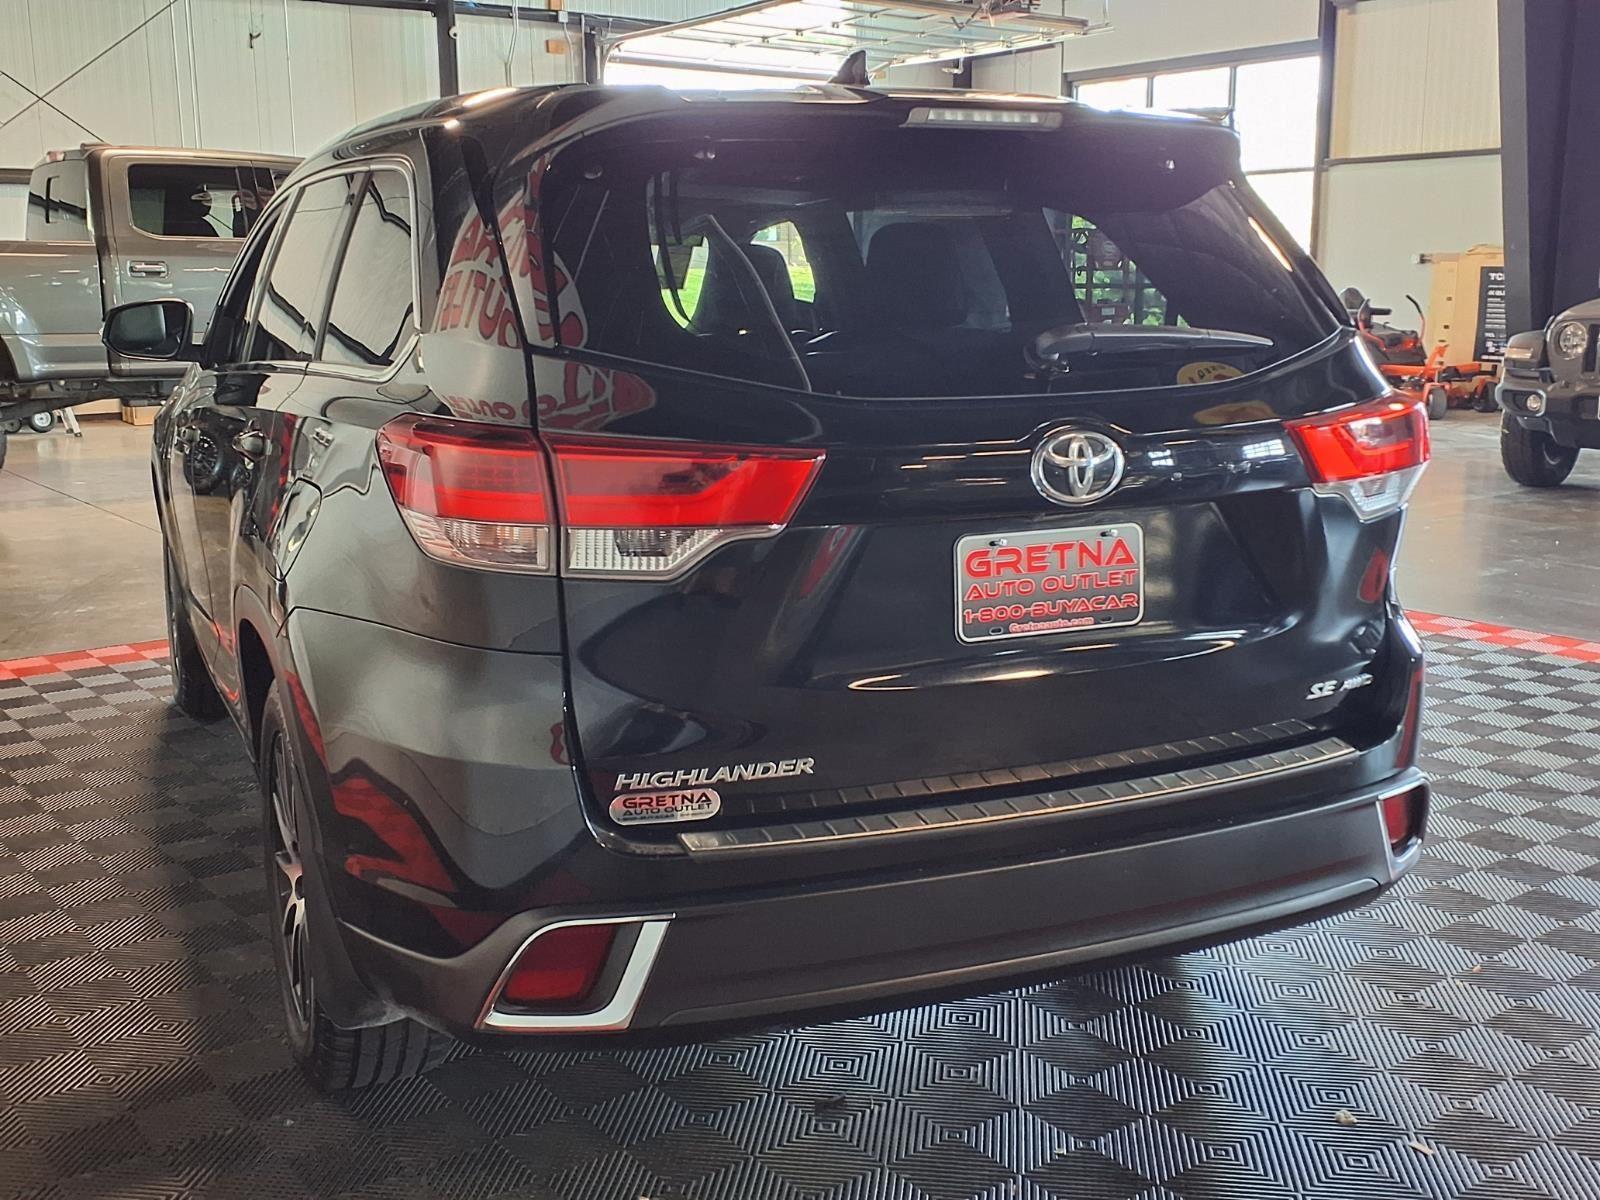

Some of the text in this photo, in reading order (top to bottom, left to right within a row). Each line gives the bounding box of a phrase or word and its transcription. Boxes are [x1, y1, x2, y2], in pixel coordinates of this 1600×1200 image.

[964, 537, 1137, 578] GRETNA
[963, 568, 1139, 601] AUTO OUTLET
[963, 593, 1138, 624] 1-800-BUYACAR
[1305, 680, 1338, 700] SE
[614, 757, 815, 791] HIGHLANDER
[622, 792, 712, 808] GRETNA
[622, 803, 712, 816] AUTO OUTLET
